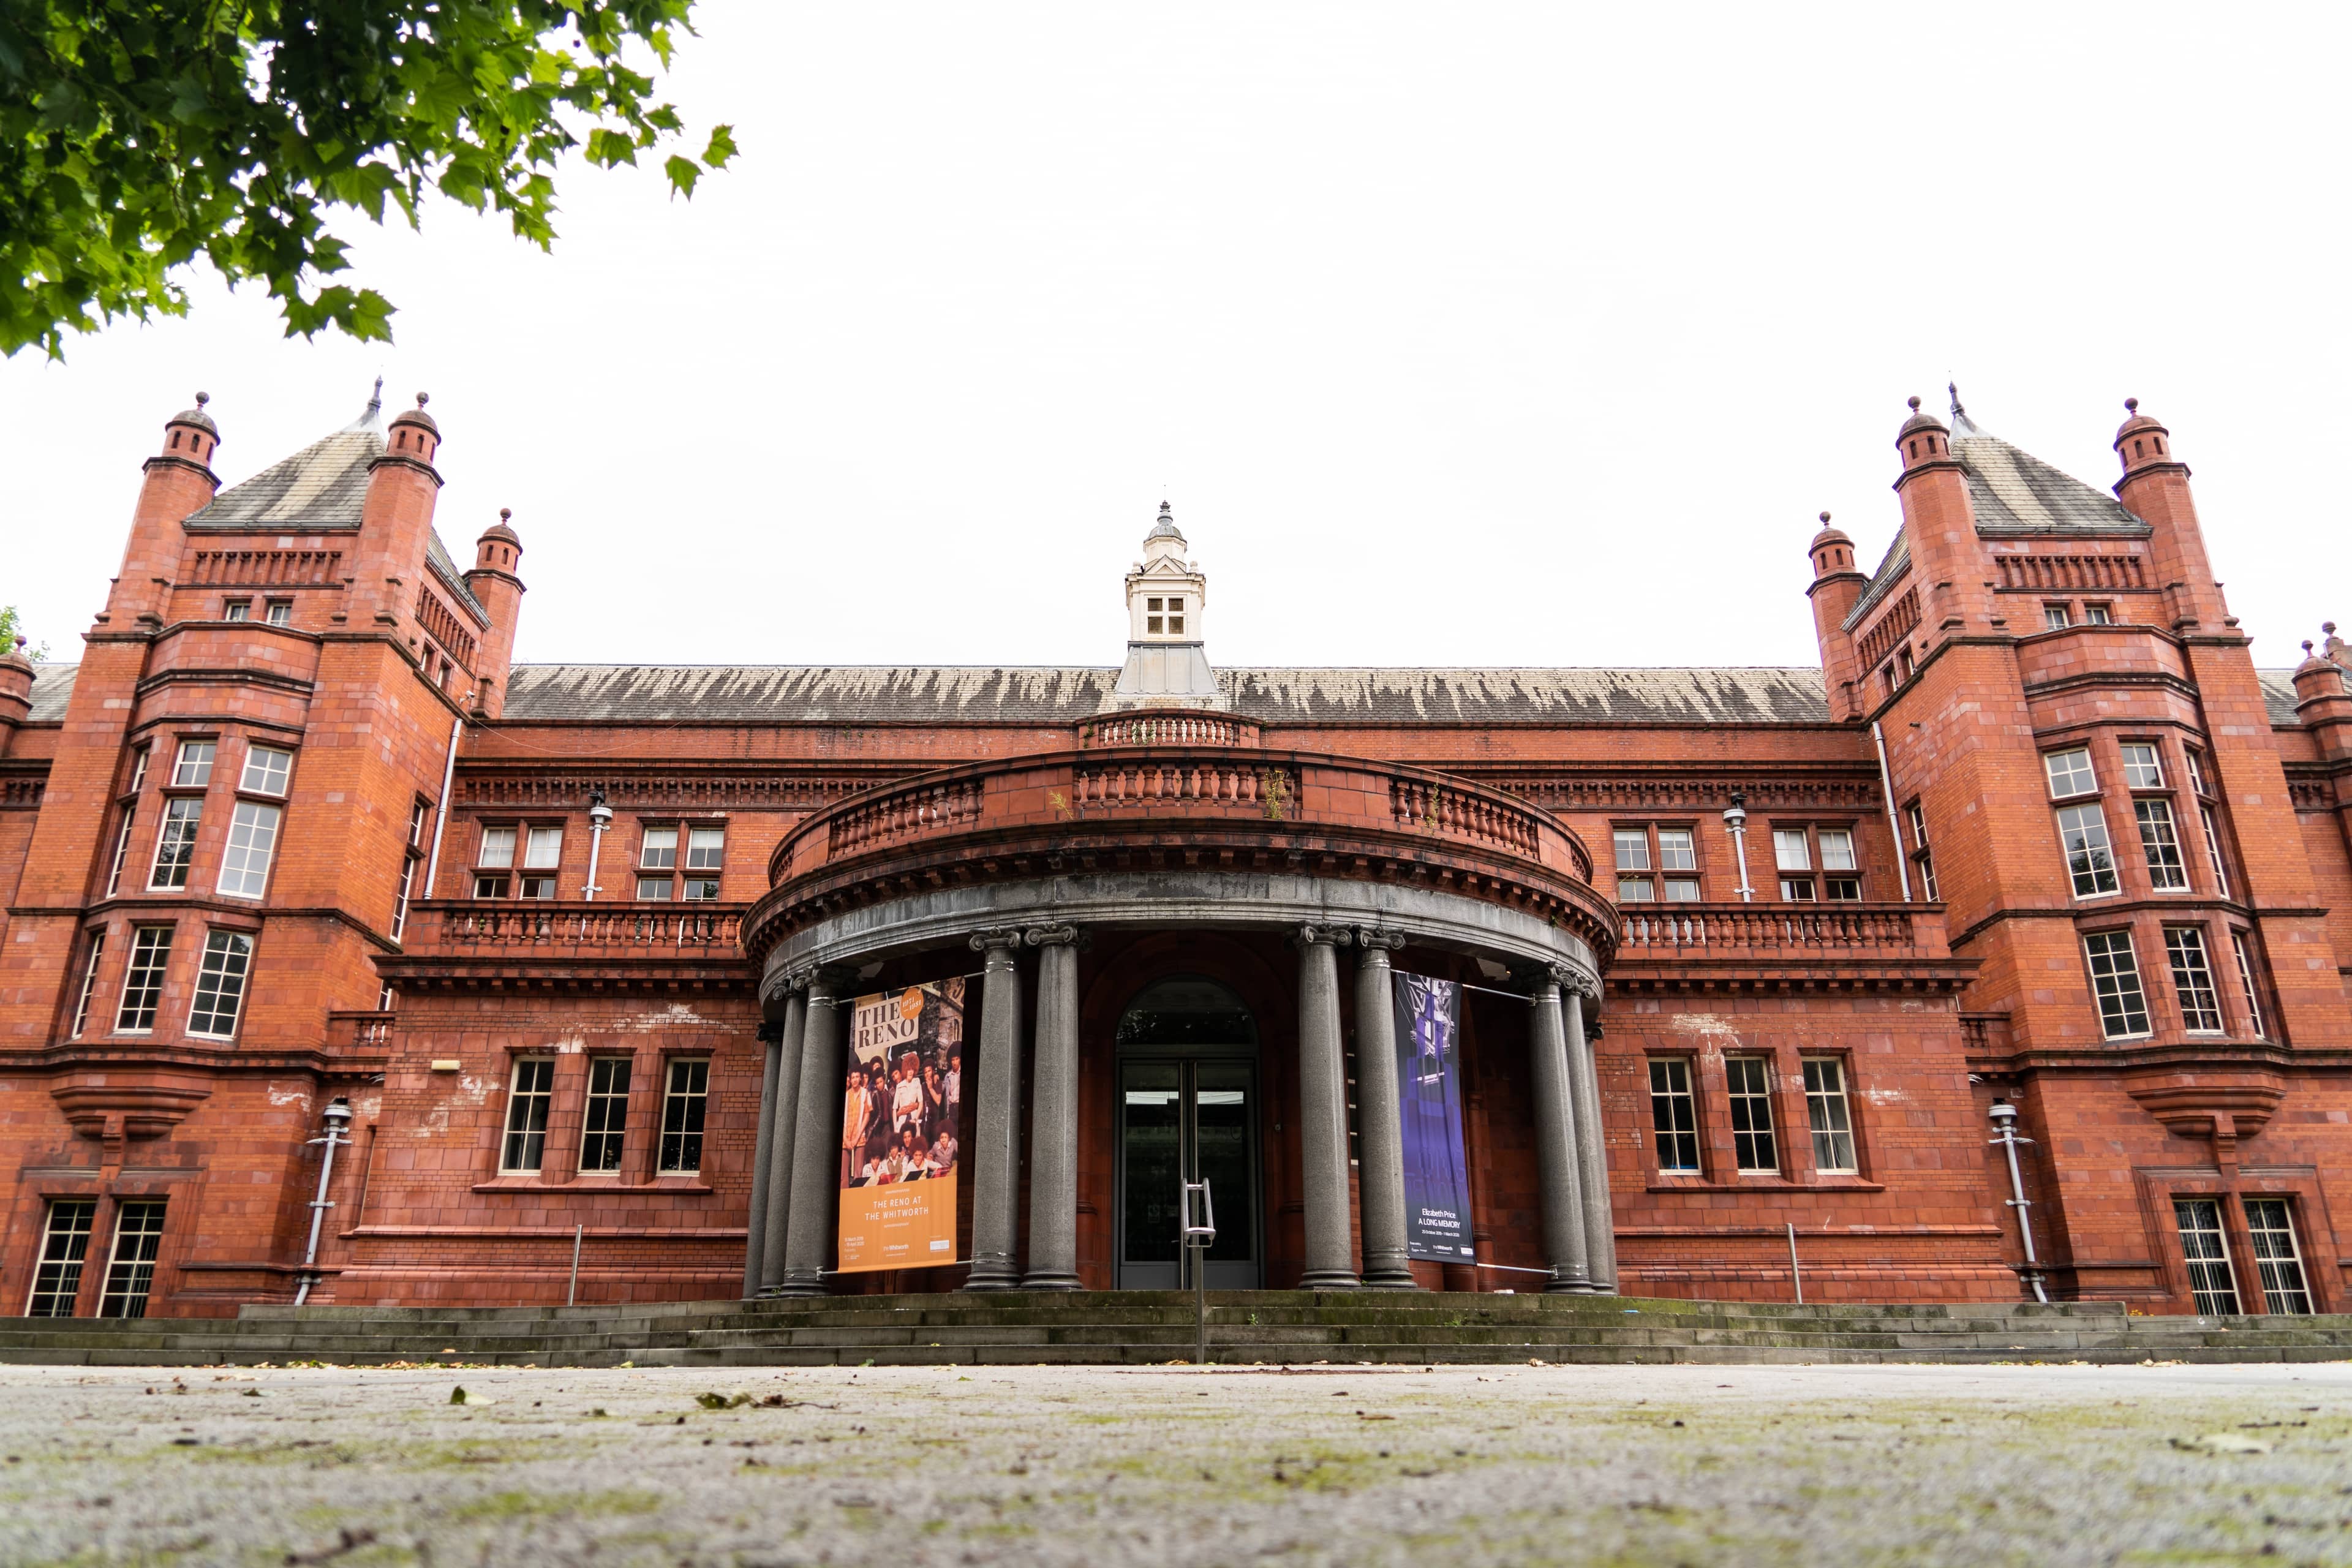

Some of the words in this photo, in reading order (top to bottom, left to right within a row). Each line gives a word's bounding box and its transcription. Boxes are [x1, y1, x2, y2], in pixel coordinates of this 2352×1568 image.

[903, 997, 915, 1008] 1971
[859, 1001, 900, 1028] THE
[858, 1019, 915, 1048] RENO
[873, 1200, 888, 1209] THE
[890, 1197, 910, 1207] RENO
[913, 1196, 922, 1204] AT
[865, 1212, 880, 1221] THE
[883, 1207, 929, 1219] WHITWORTH
[1422, 1208, 1444, 1218] Elizabeth
[1444, 1210, 1456, 1219] Price
[1423, 1218, 1438, 1227] LONG
[1438, 1219, 1460, 1229] MEMORY
